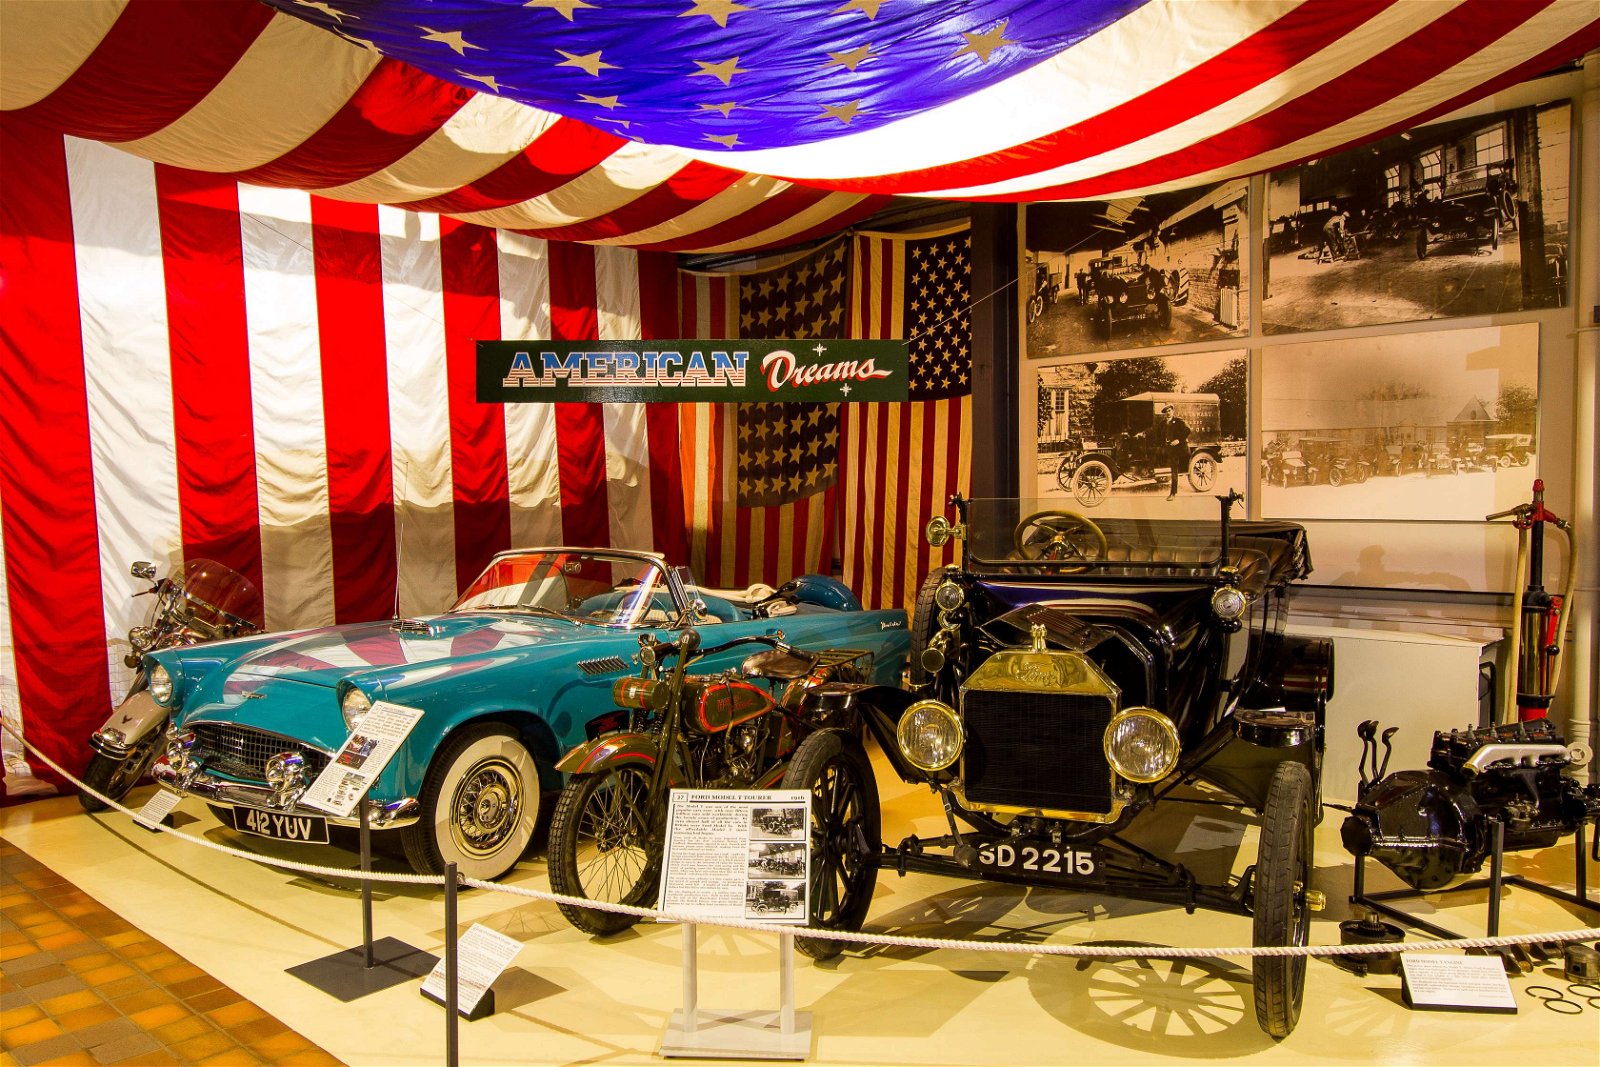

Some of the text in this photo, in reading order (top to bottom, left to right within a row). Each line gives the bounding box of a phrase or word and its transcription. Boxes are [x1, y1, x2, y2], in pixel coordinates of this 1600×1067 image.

[502, 350, 893, 393] AMERICAN Dreams
[246, 809, 312, 840] 412 YUV
[978, 843, 1095, 876] SD 2215
